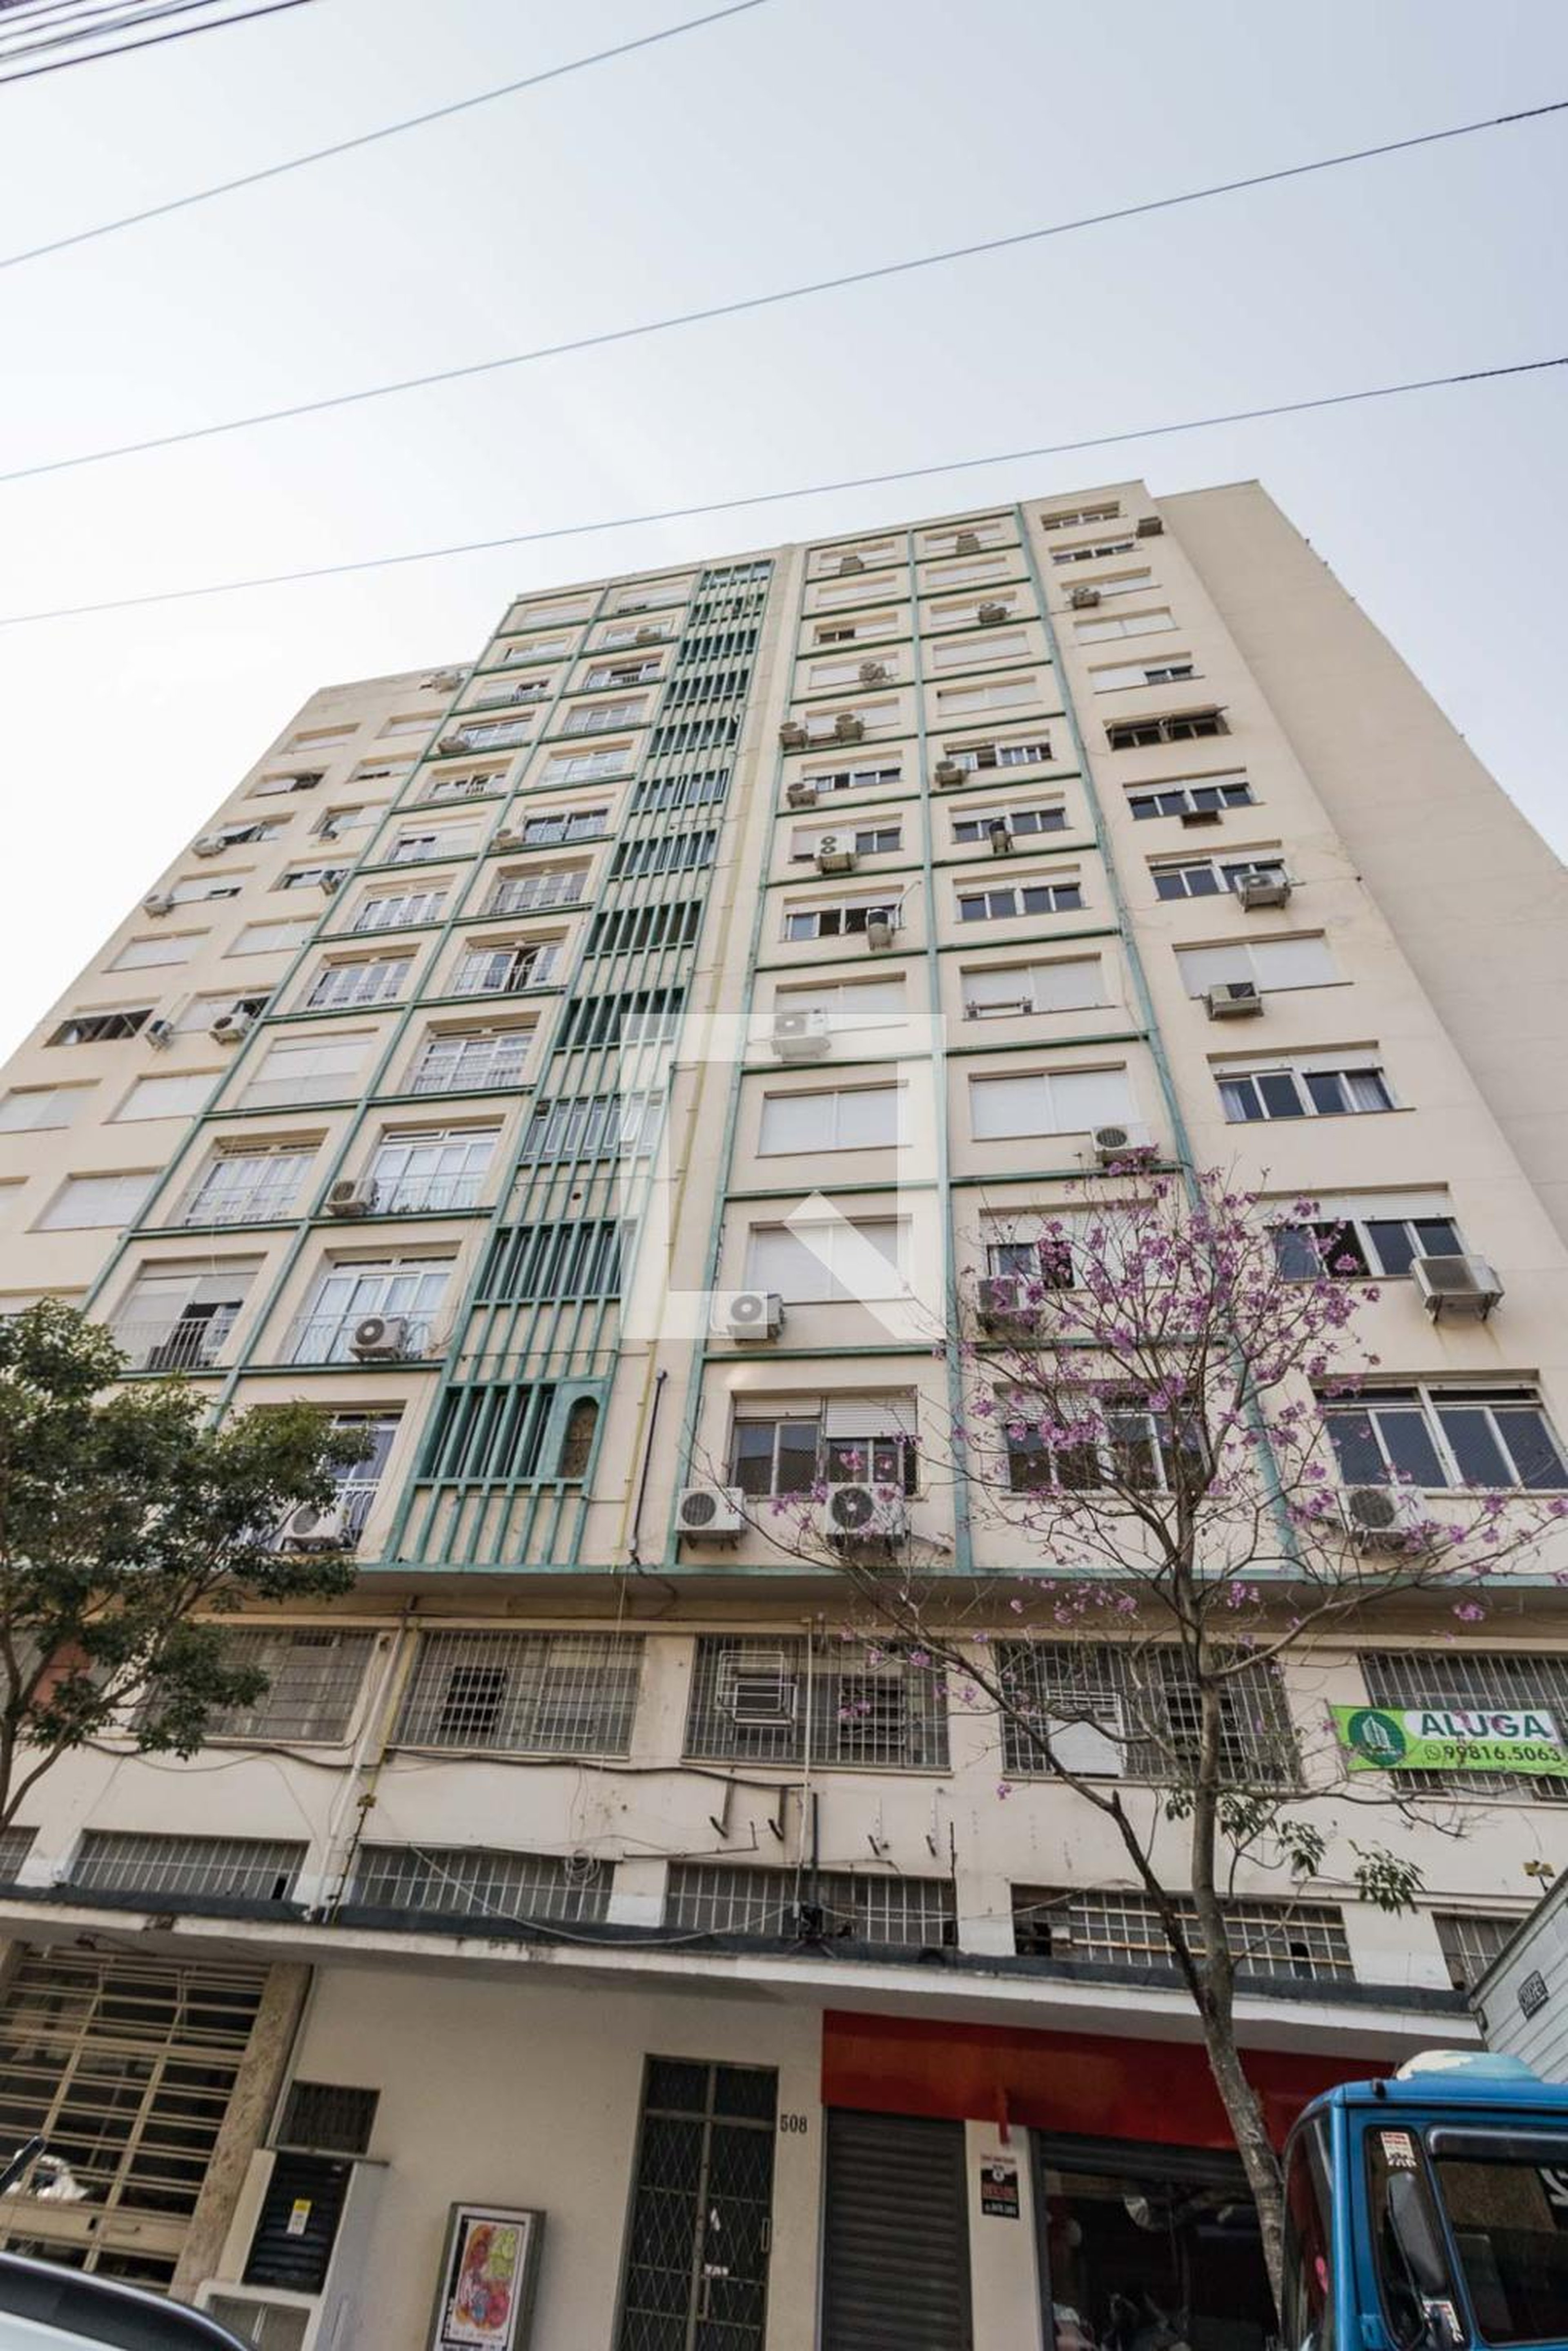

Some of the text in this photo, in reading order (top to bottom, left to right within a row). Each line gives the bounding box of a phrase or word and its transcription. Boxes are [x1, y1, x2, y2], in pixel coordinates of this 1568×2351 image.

[1422, 1713, 1551, 1738] ALUGA
[1444, 1745, 1561, 1761] 99816.5063
[780, 2114, 807, 2134] 508
